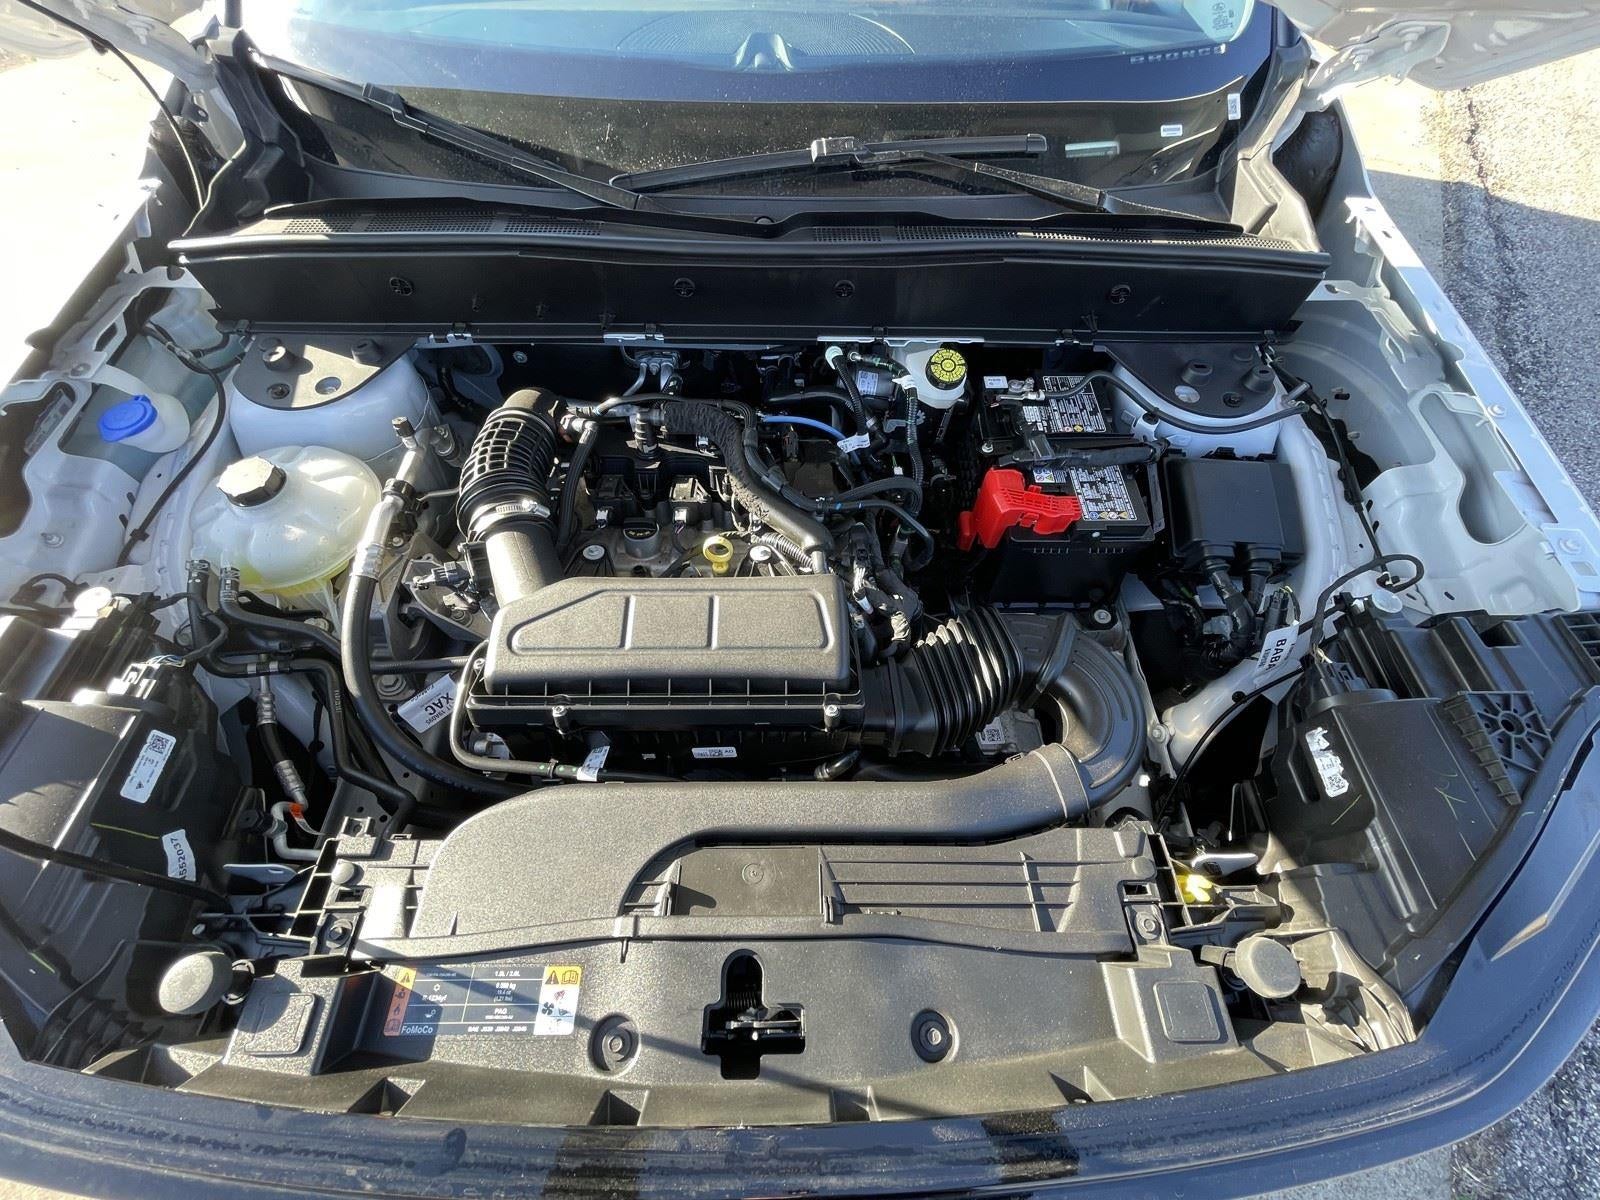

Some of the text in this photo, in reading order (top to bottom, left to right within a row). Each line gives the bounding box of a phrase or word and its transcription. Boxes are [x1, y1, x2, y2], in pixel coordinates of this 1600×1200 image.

[1264, 638, 1287, 671] BABA
[424, 692, 454, 716] XAC
[401, 1025, 434, 1035] FoMoCo
